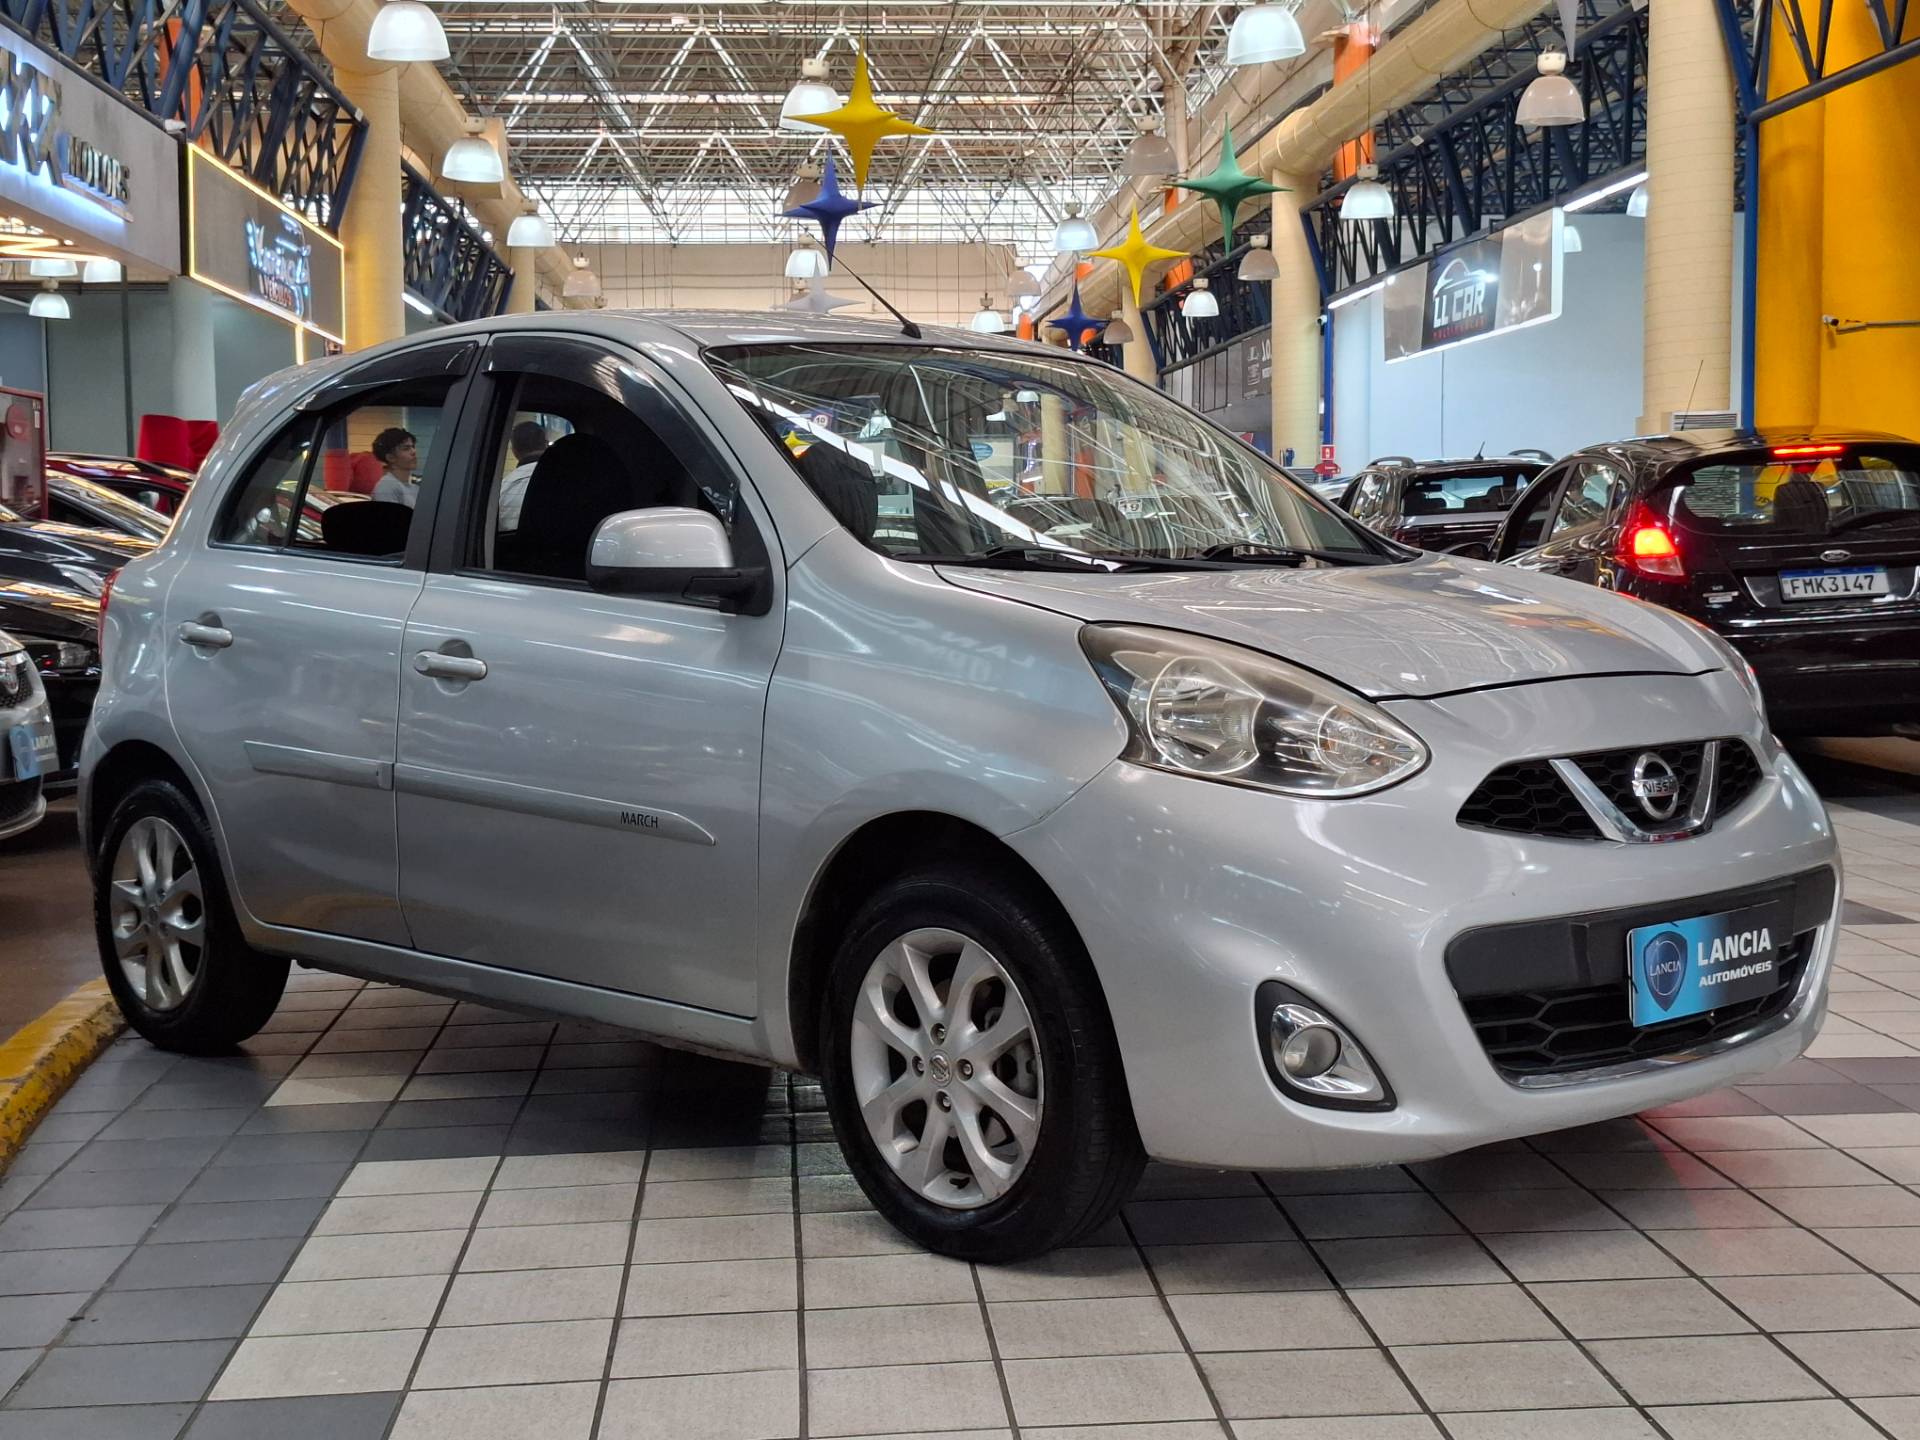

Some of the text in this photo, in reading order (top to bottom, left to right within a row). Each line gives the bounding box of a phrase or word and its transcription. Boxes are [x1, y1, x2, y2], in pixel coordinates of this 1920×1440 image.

[1452, 281, 1486, 322] CAR
[1789, 574, 1875, 595] FMK3147
[620, 811, 658, 829] MARCH
[1697, 927, 1772, 967] LANCIA
[1649, 960, 1682, 977] LANCIA
[1699, 960, 1773, 987] AUTOMÓVEIS
